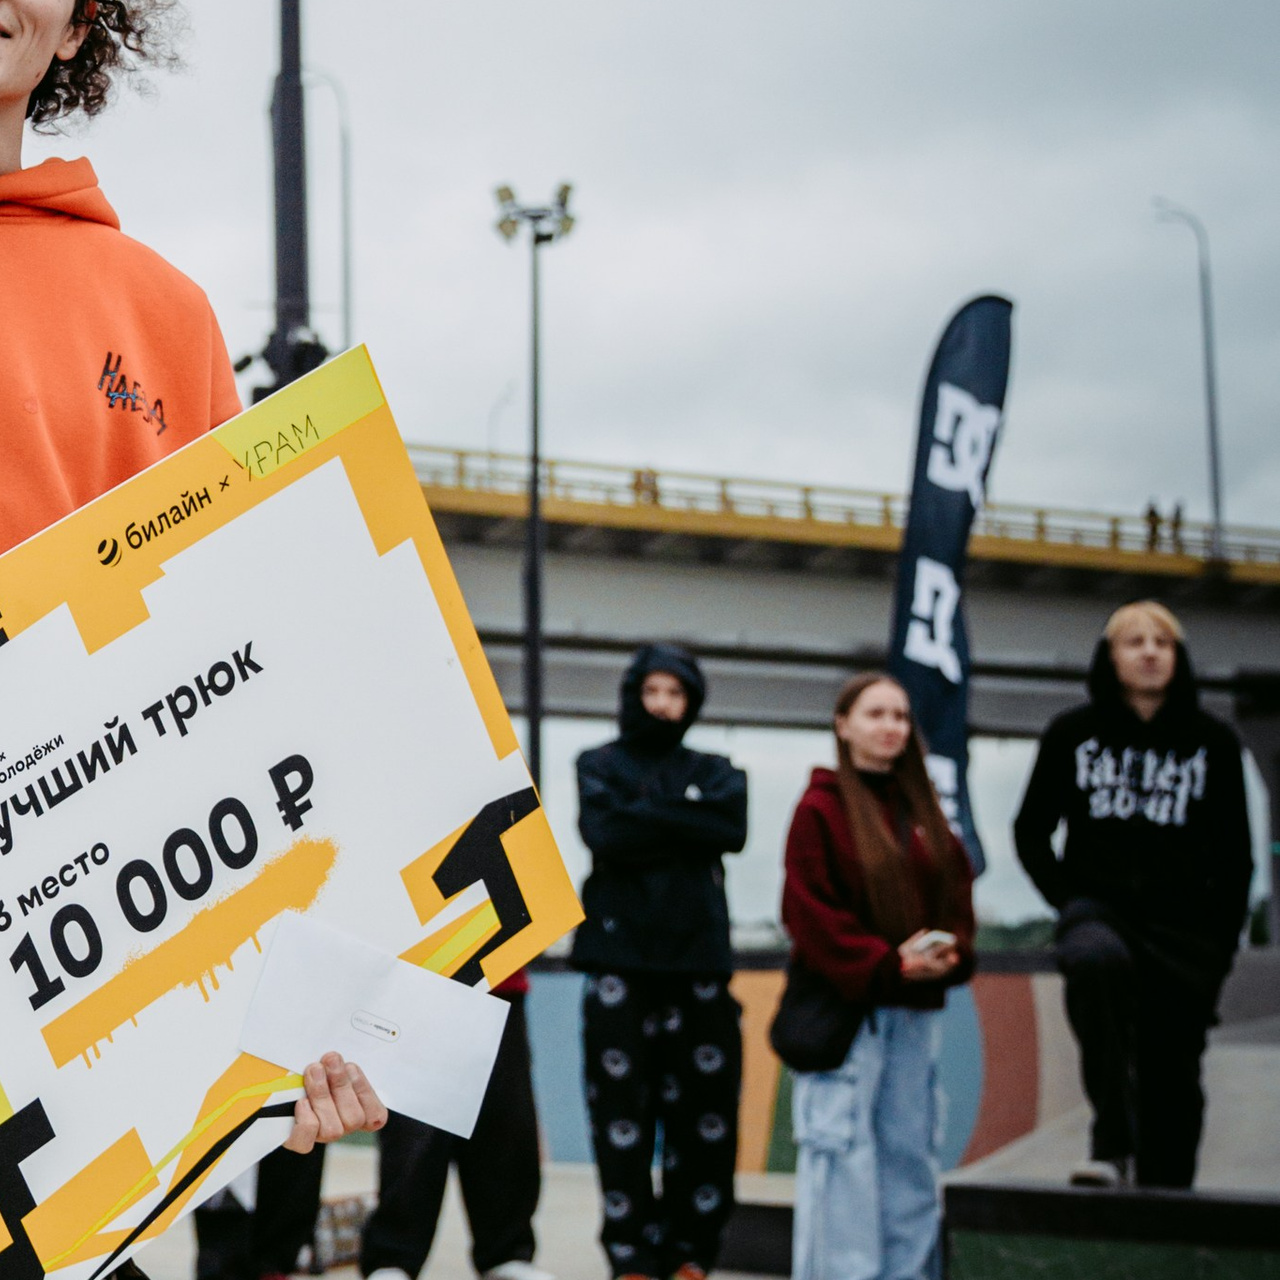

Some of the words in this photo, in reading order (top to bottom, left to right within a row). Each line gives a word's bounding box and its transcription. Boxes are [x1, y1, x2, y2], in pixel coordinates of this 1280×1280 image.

[125, 487, 212, 549] билайн
[233, 414, 320, 482] УРАМ
[141, 640, 264, 737] трюк
[9, 903, 103, 1011] 10
[116, 797, 258, 933] 000
[17, 842, 110, 916] место
